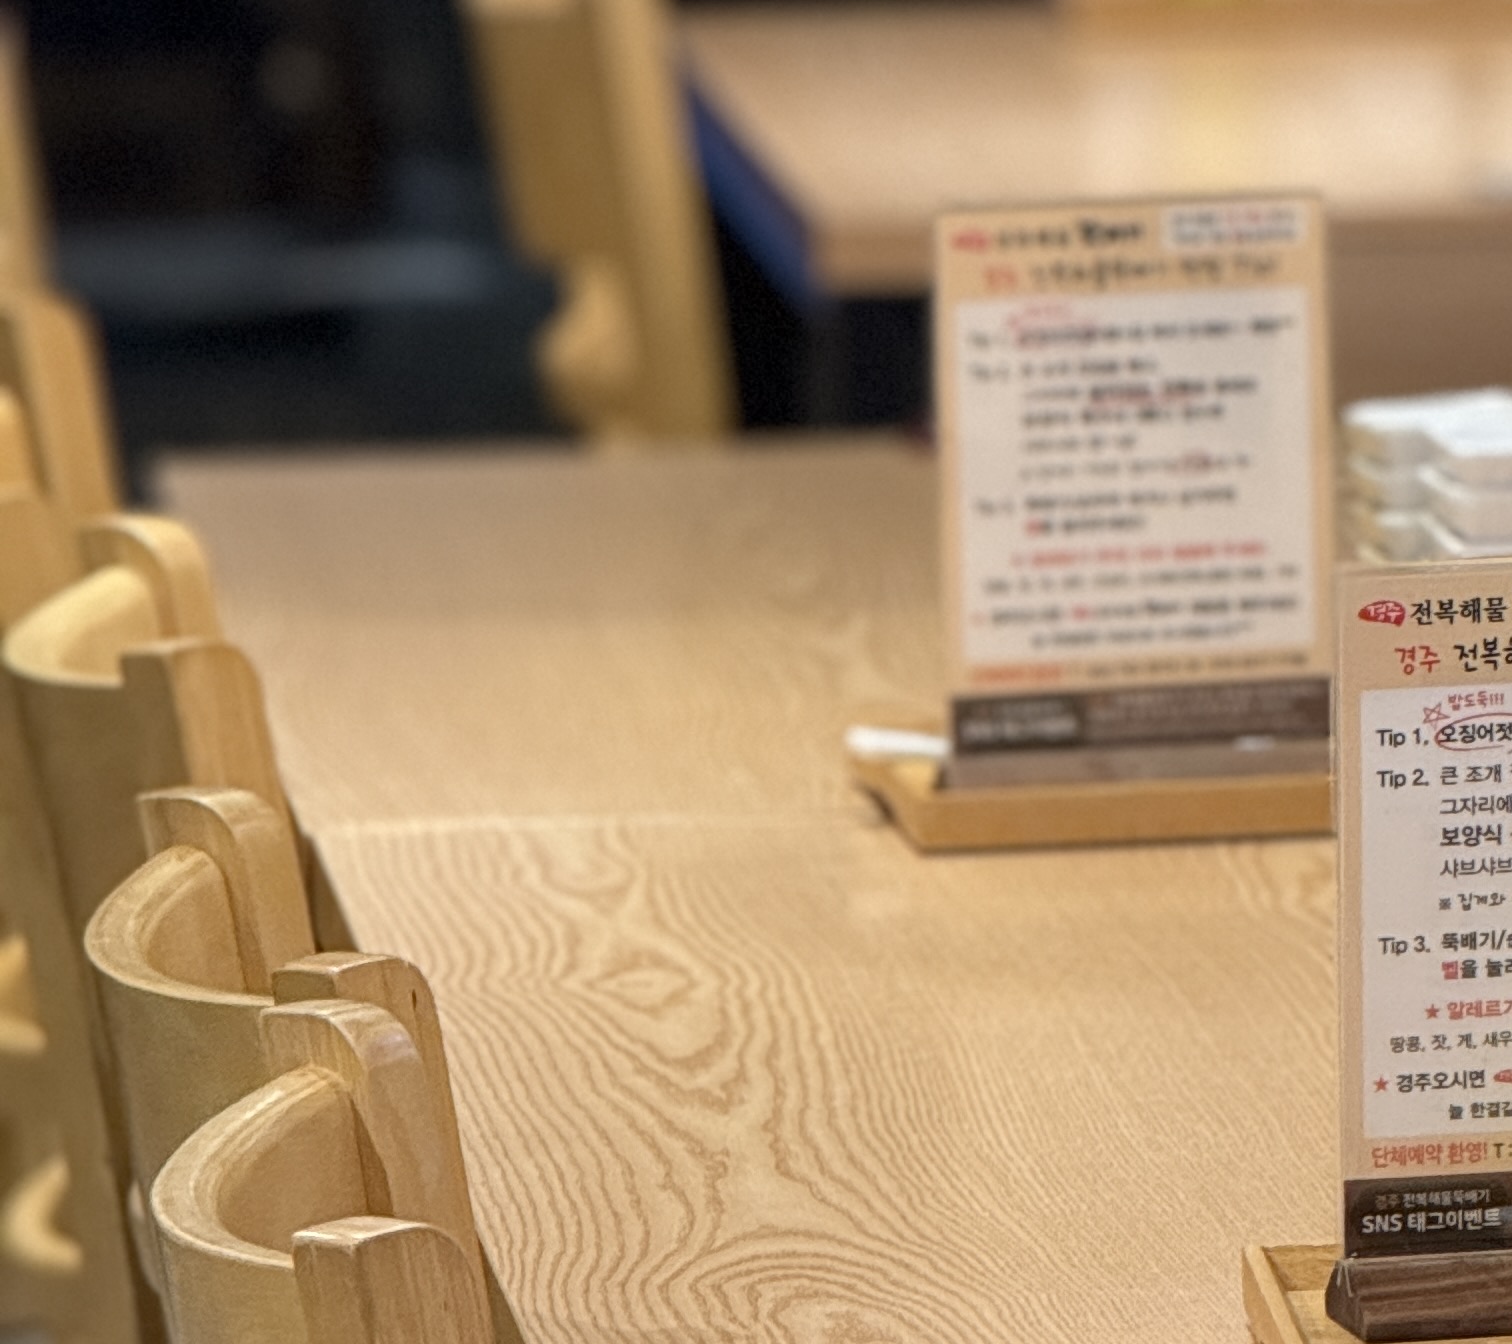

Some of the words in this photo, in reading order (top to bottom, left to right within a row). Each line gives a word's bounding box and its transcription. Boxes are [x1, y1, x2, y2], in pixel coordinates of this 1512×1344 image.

[1410, 596, 1508, 626] 전복해물
[1394, 645, 1441, 676] 경주
[1375, 729, 1406, 748] Tip
[1412, 729, 1430, 747] 1.
[1376, 769, 1407, 790] Tip
[1411, 768, 1430, 787] 2.
[1439, 766, 1459, 785] 큰
[1465, 763, 1502, 784] 조개
[1439, 823, 1503, 847] 보양식
[1378, 936, 1408, 957] Tip
[1413, 935, 1431, 954] 3.
[1441, 958, 1479, 981] 벨을
[1395, 1069, 1486, 1093] 경주오시면
[1370, 1142, 1444, 1169] 단체예약
[1447, 1140, 1488, 1165] 환영!
[1361, 1213, 1404, 1234] SNS
[1406, 1207, 1503, 1233] 태그이벤트
